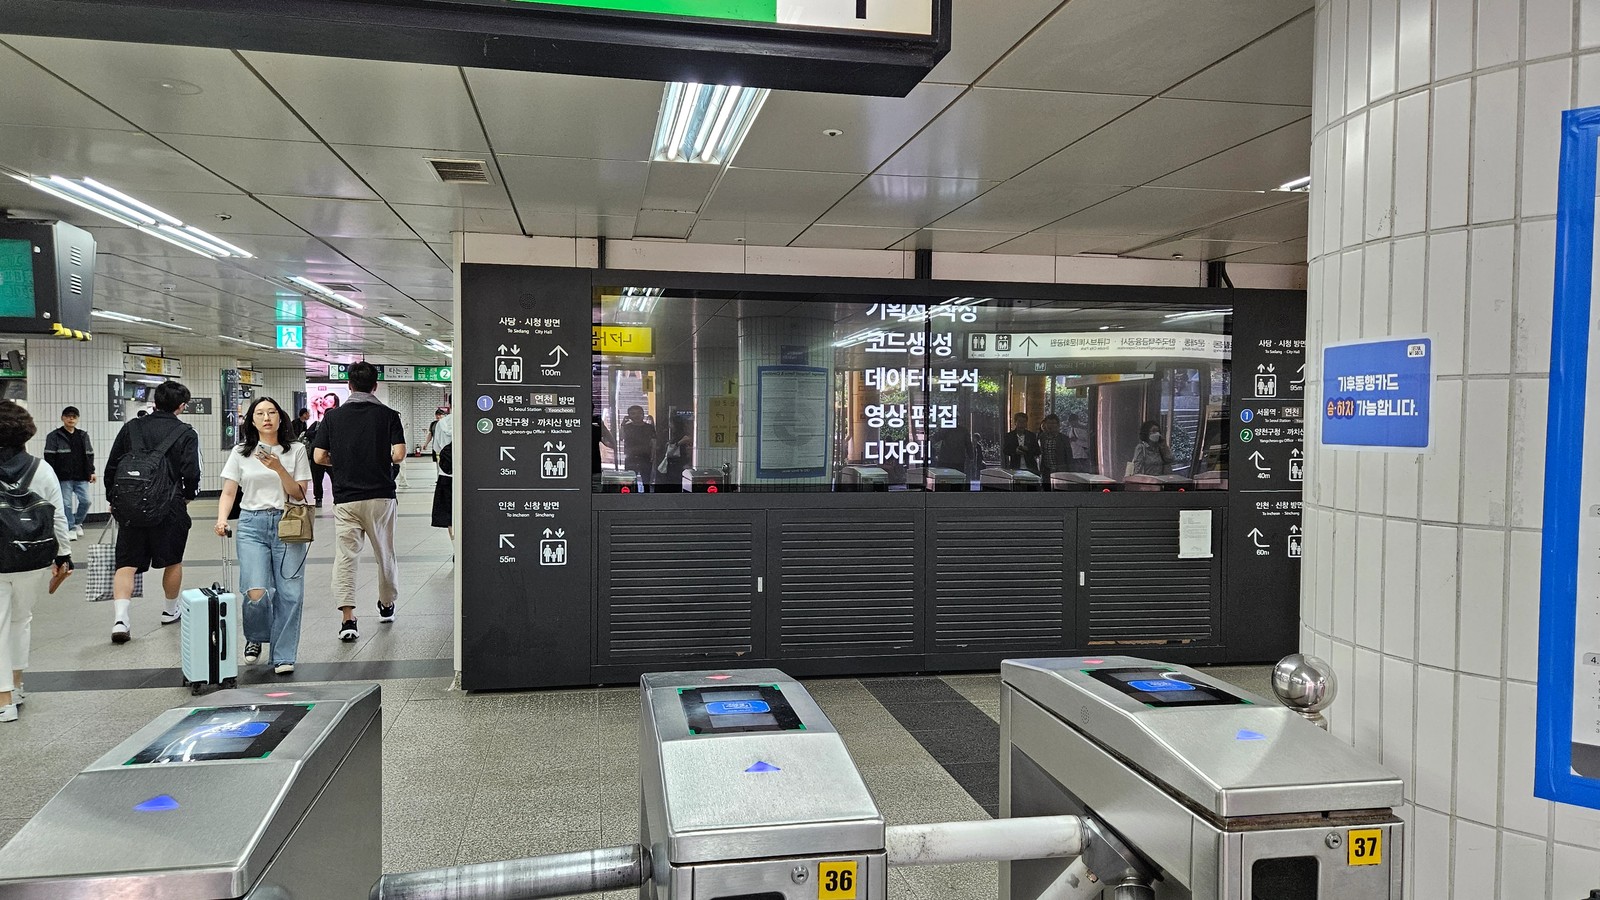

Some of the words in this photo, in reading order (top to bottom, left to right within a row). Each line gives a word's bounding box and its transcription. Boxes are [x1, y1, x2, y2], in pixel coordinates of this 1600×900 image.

[499, 317, 516, 326] 사당
[525, 318, 541, 327] 시청
[544, 318, 560, 328] 방면
[865, 367, 932, 392] 데이터
[938, 368, 980, 393] 분석
[1338, 374, 1399, 392] 기후동행카드
[498, 395, 522, 404] 서울역
[534, 394, 553, 405] 연천
[558, 396, 575, 405] 방면
[1257, 408, 1276, 417] 서울역
[1357, 399, 1419, 416] 가능합니다.
[864, 404, 908, 428] 영상
[911, 404, 958, 428] 편집
[496, 418, 529, 427] 양천구청
[537, 418, 562, 427] 까치산
[565, 419, 581, 428] 방면
[1254, 428, 1281, 437] 양천구청
[500, 468, 517, 476] 35m
[498, 501, 516, 511] 인천
[524, 501, 541, 511] 신창
[543, 501, 560, 511] 방면
[1256, 501, 1270, 510] 인천
[499, 556, 516, 564] 55m
[1354, 837, 1377, 857] 37
[825, 870, 853, 892] 36
